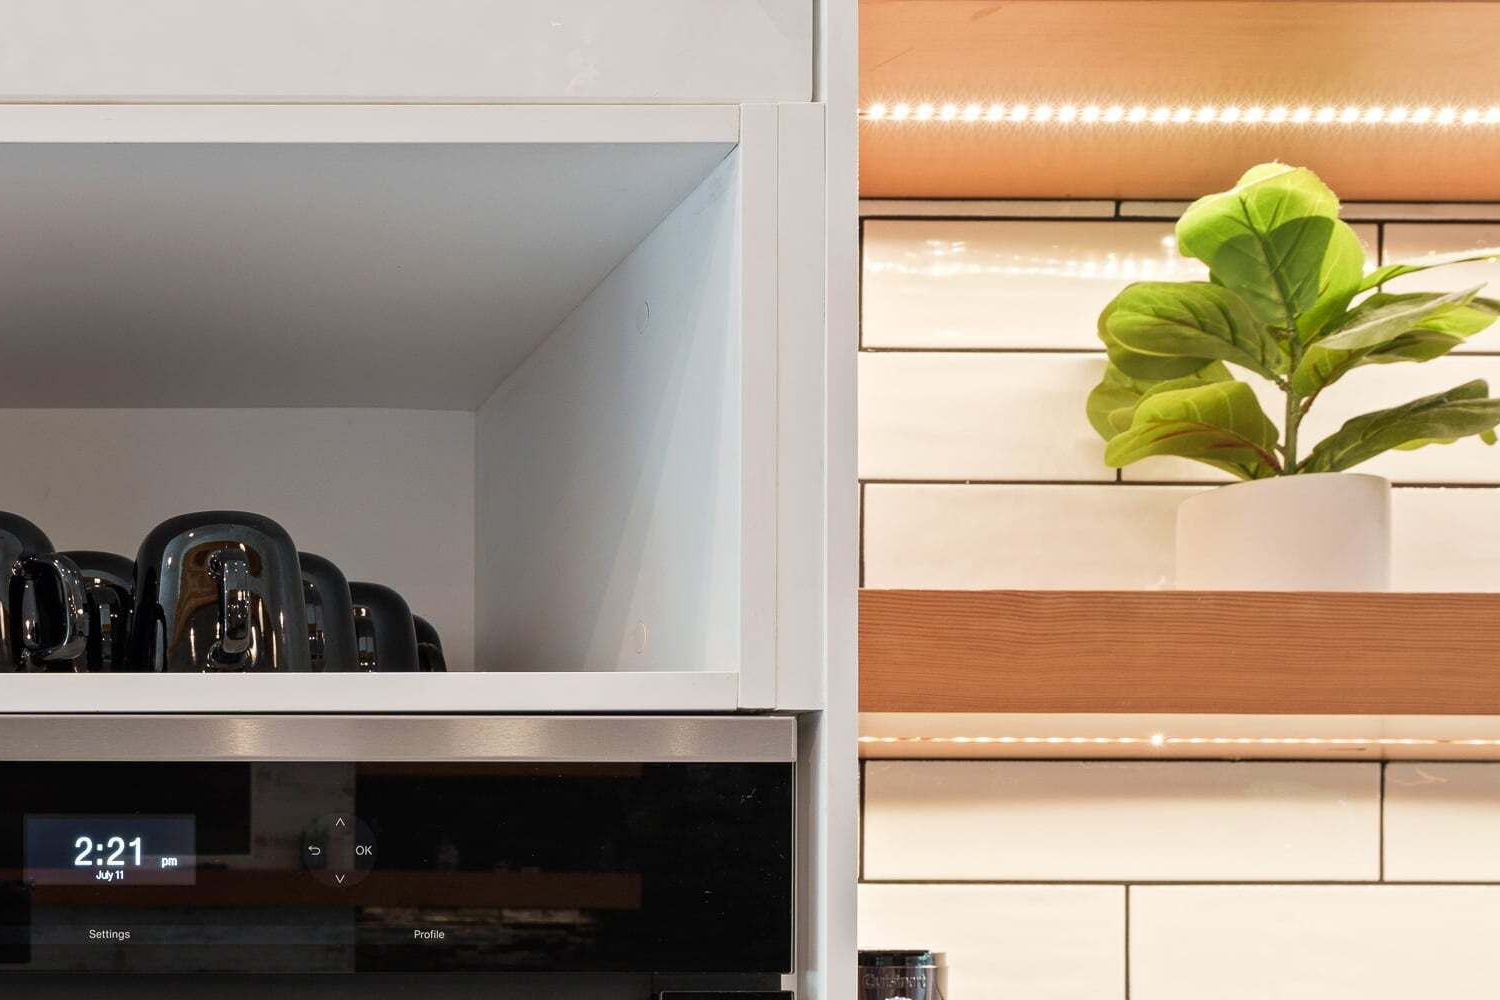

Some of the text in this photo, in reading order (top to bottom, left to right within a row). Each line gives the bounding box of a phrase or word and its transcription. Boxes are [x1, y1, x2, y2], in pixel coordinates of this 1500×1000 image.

[74, 836, 178, 868] 2:21 pm
[355, 845, 373, 856] OK
[96, 870, 124, 882] July 11
[89, 929, 131, 941] Settings
[414, 929, 445, 939] Profile
